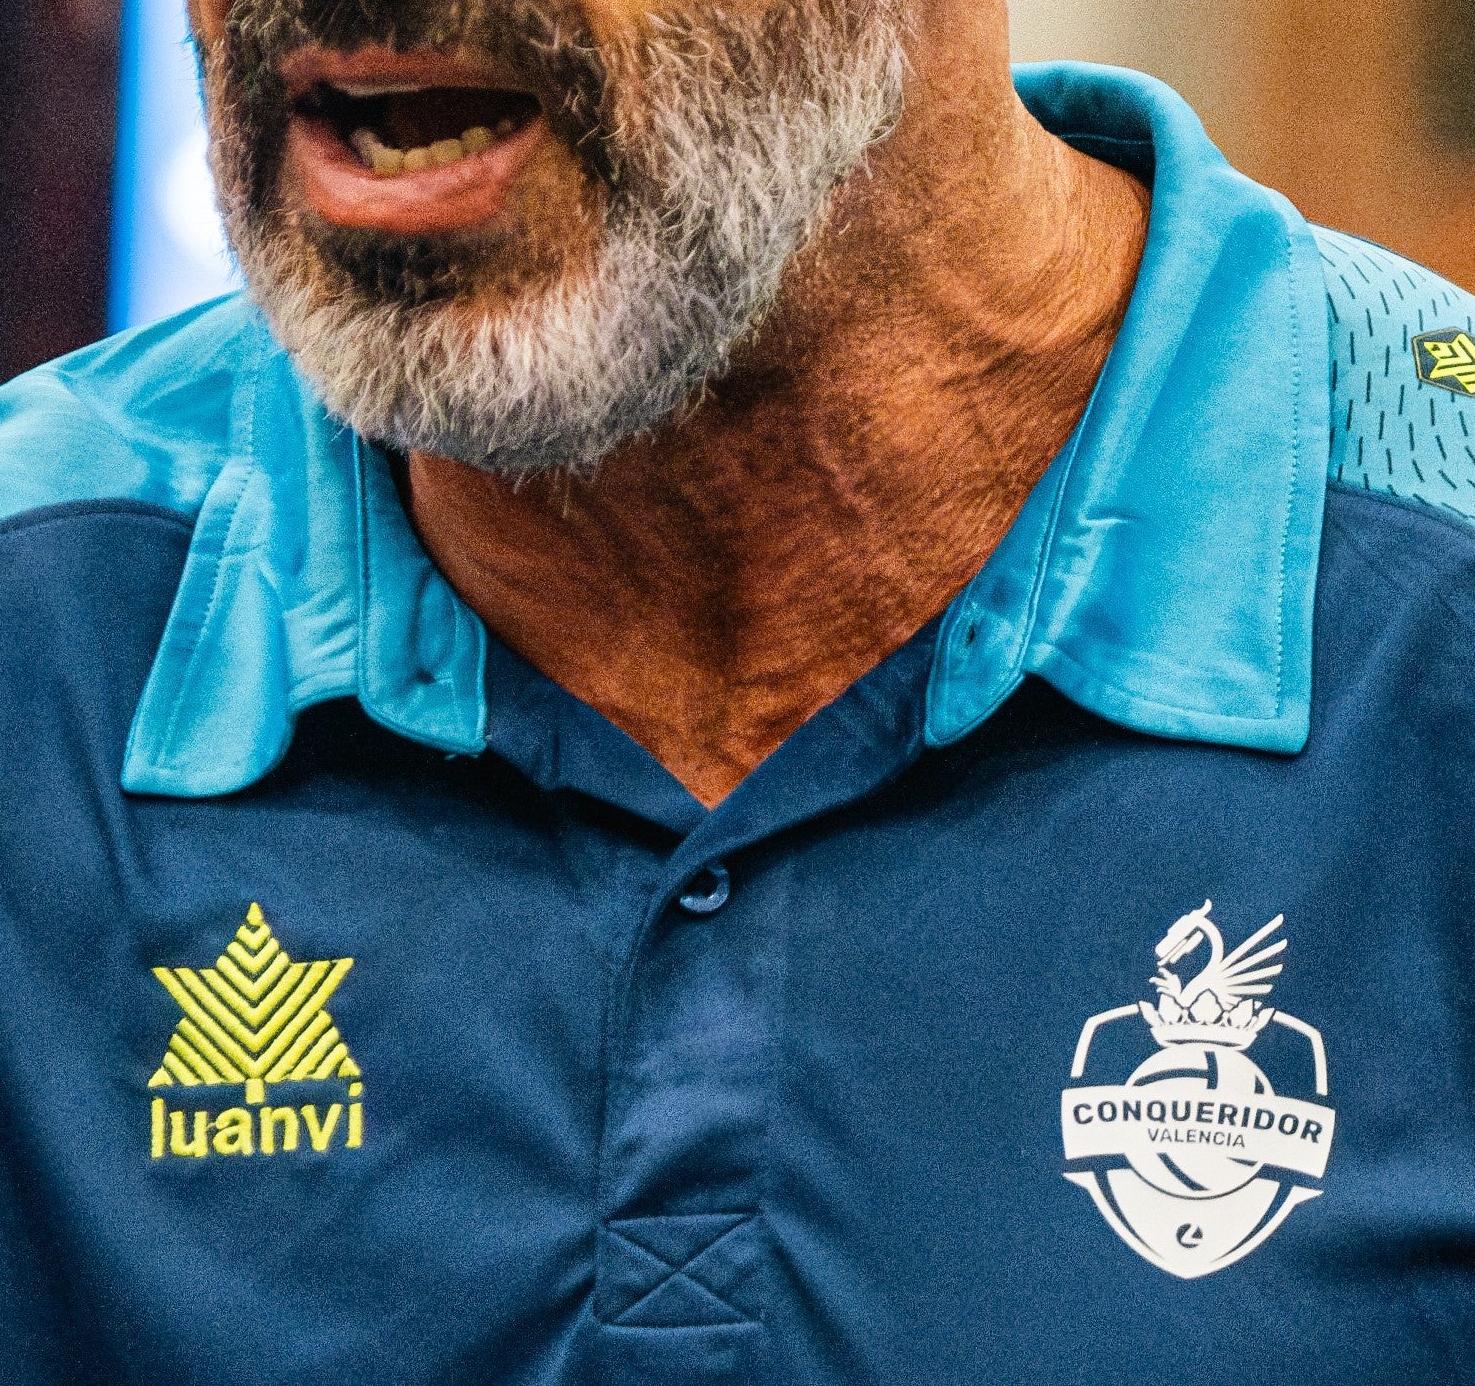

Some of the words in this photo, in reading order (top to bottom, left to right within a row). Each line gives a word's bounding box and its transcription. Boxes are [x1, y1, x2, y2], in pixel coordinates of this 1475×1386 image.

[149, 1082, 364, 1159] luanvi
[1072, 1099, 1325, 1145] CONQUERIDOR
[1147, 1126, 1247, 1149] VALENCIA
